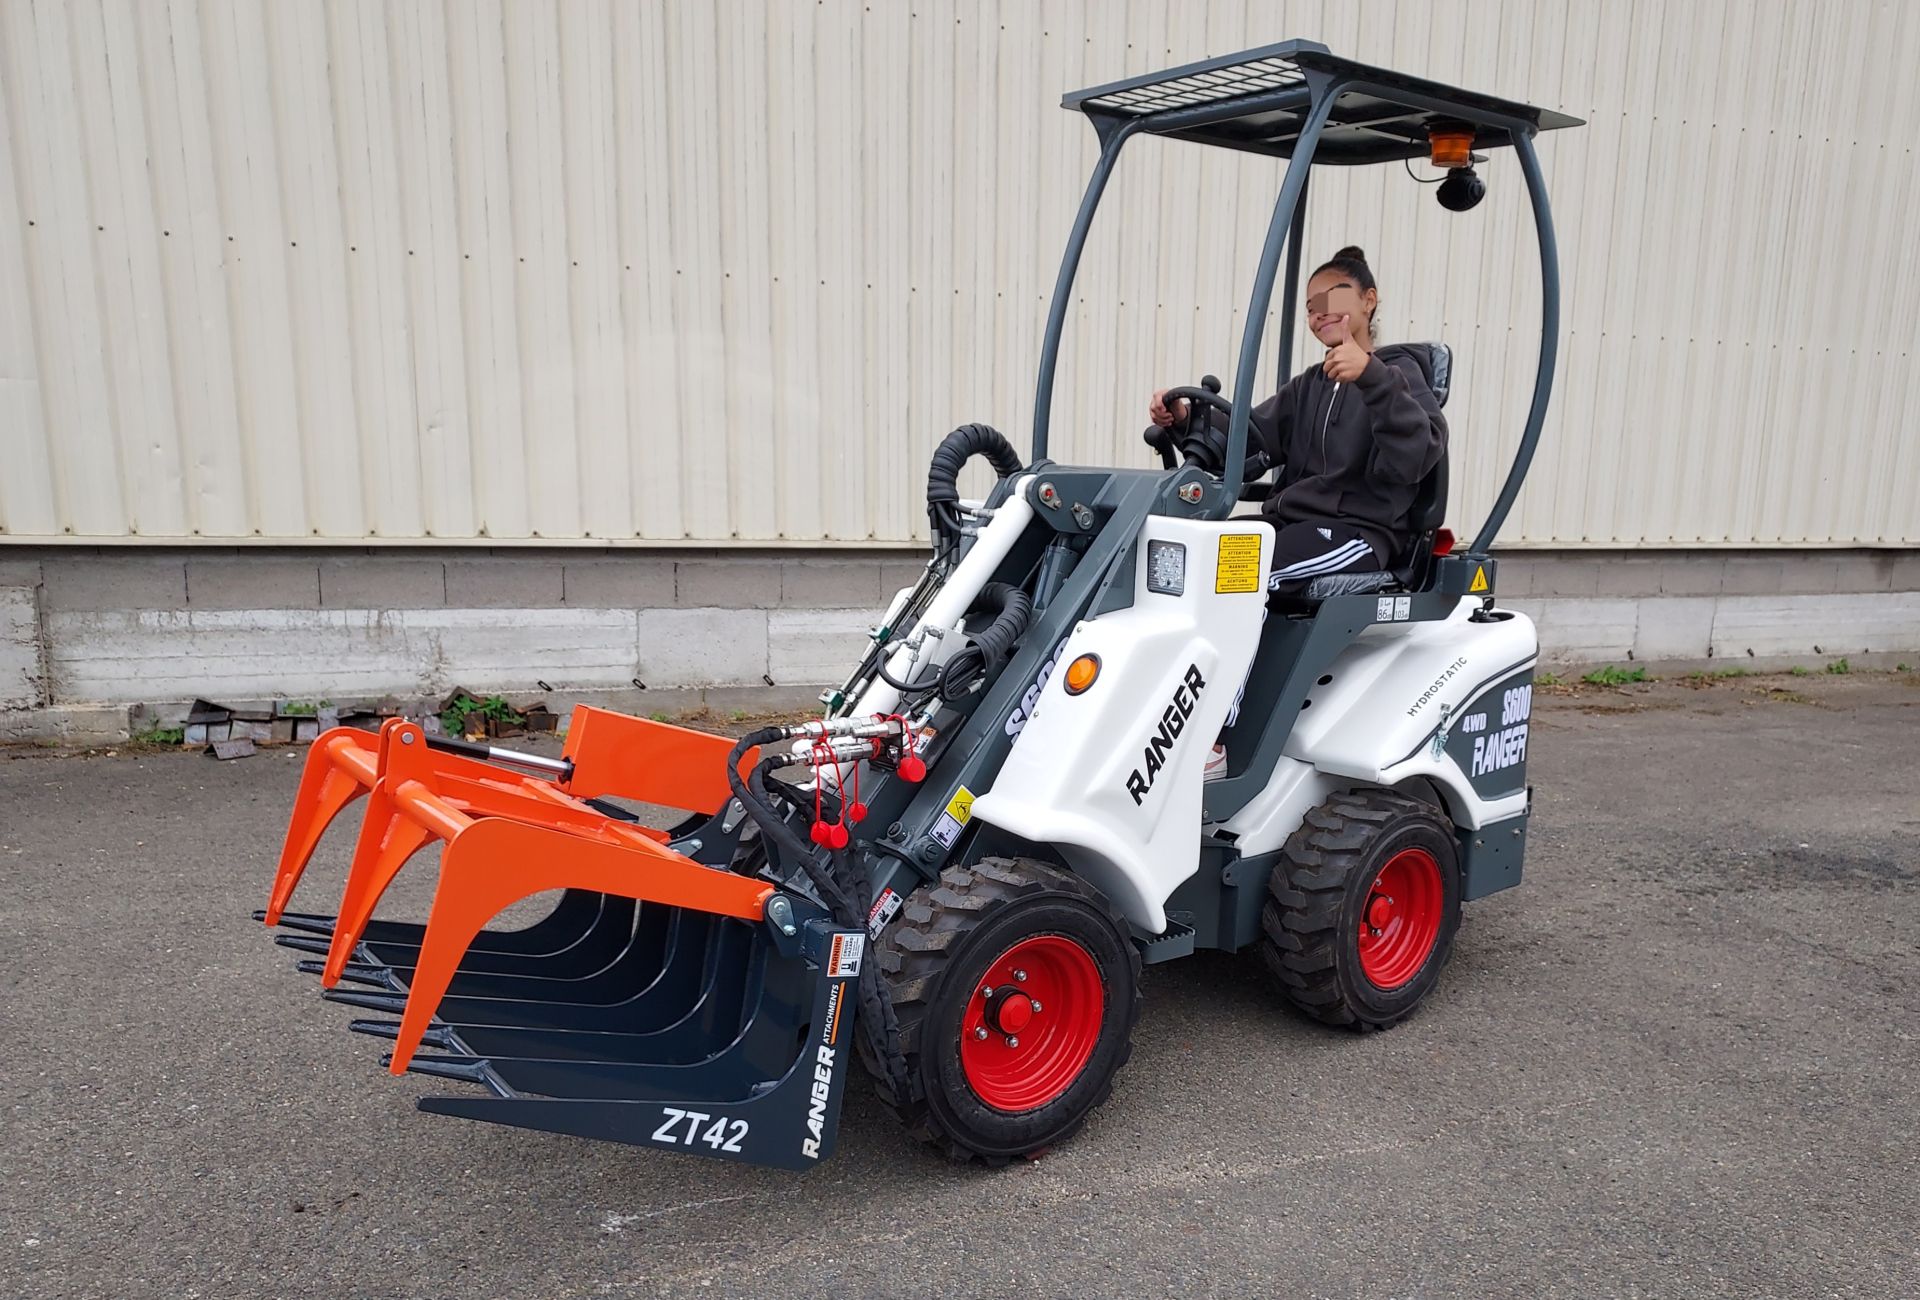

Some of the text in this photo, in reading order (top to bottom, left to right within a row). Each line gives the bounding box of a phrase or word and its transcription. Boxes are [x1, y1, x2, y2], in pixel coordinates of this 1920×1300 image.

[1406, 656, 1468, 717] HYDROSTATIC
[1501, 684, 1532, 726] S600
[1126, 663, 1206, 806] RANGER
[1462, 712, 1487, 733] 4WD
[1471, 723, 1528, 778] RANGER
[830, 936, 842, 974] WARNING
[822, 983, 839, 1045] ATTACHMENTS
[651, 1107, 749, 1153] ZT42
[802, 1045, 836, 1160] RANGER
